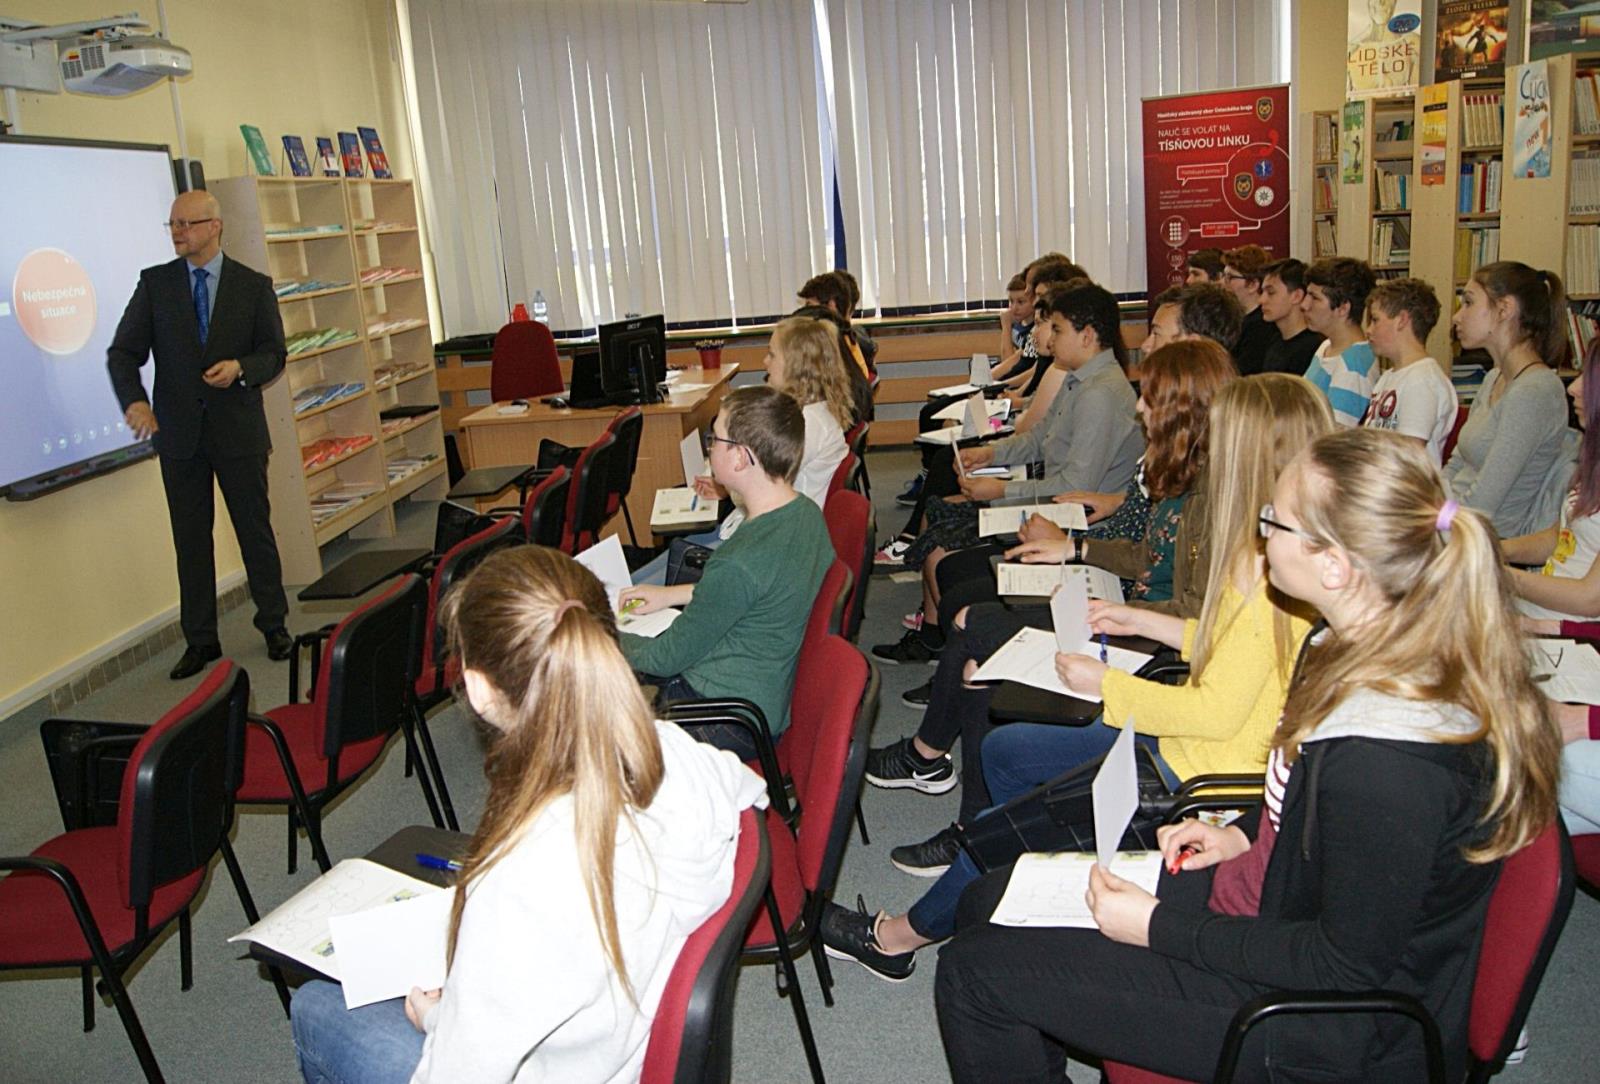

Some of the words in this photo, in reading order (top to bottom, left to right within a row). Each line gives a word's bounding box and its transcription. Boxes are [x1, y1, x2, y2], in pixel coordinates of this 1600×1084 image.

[1359, 59, 1405, 76] TĚLO
[1158, 127, 1180, 137] NAUČ
[1181, 127, 1191, 135] SE
[1192, 125, 1217, 134] VOLAT
[1219, 123, 1231, 132] NA
[1158, 138, 1215, 151] TÍSŇOVOU
[1217, 135, 1250, 147] LINKU
